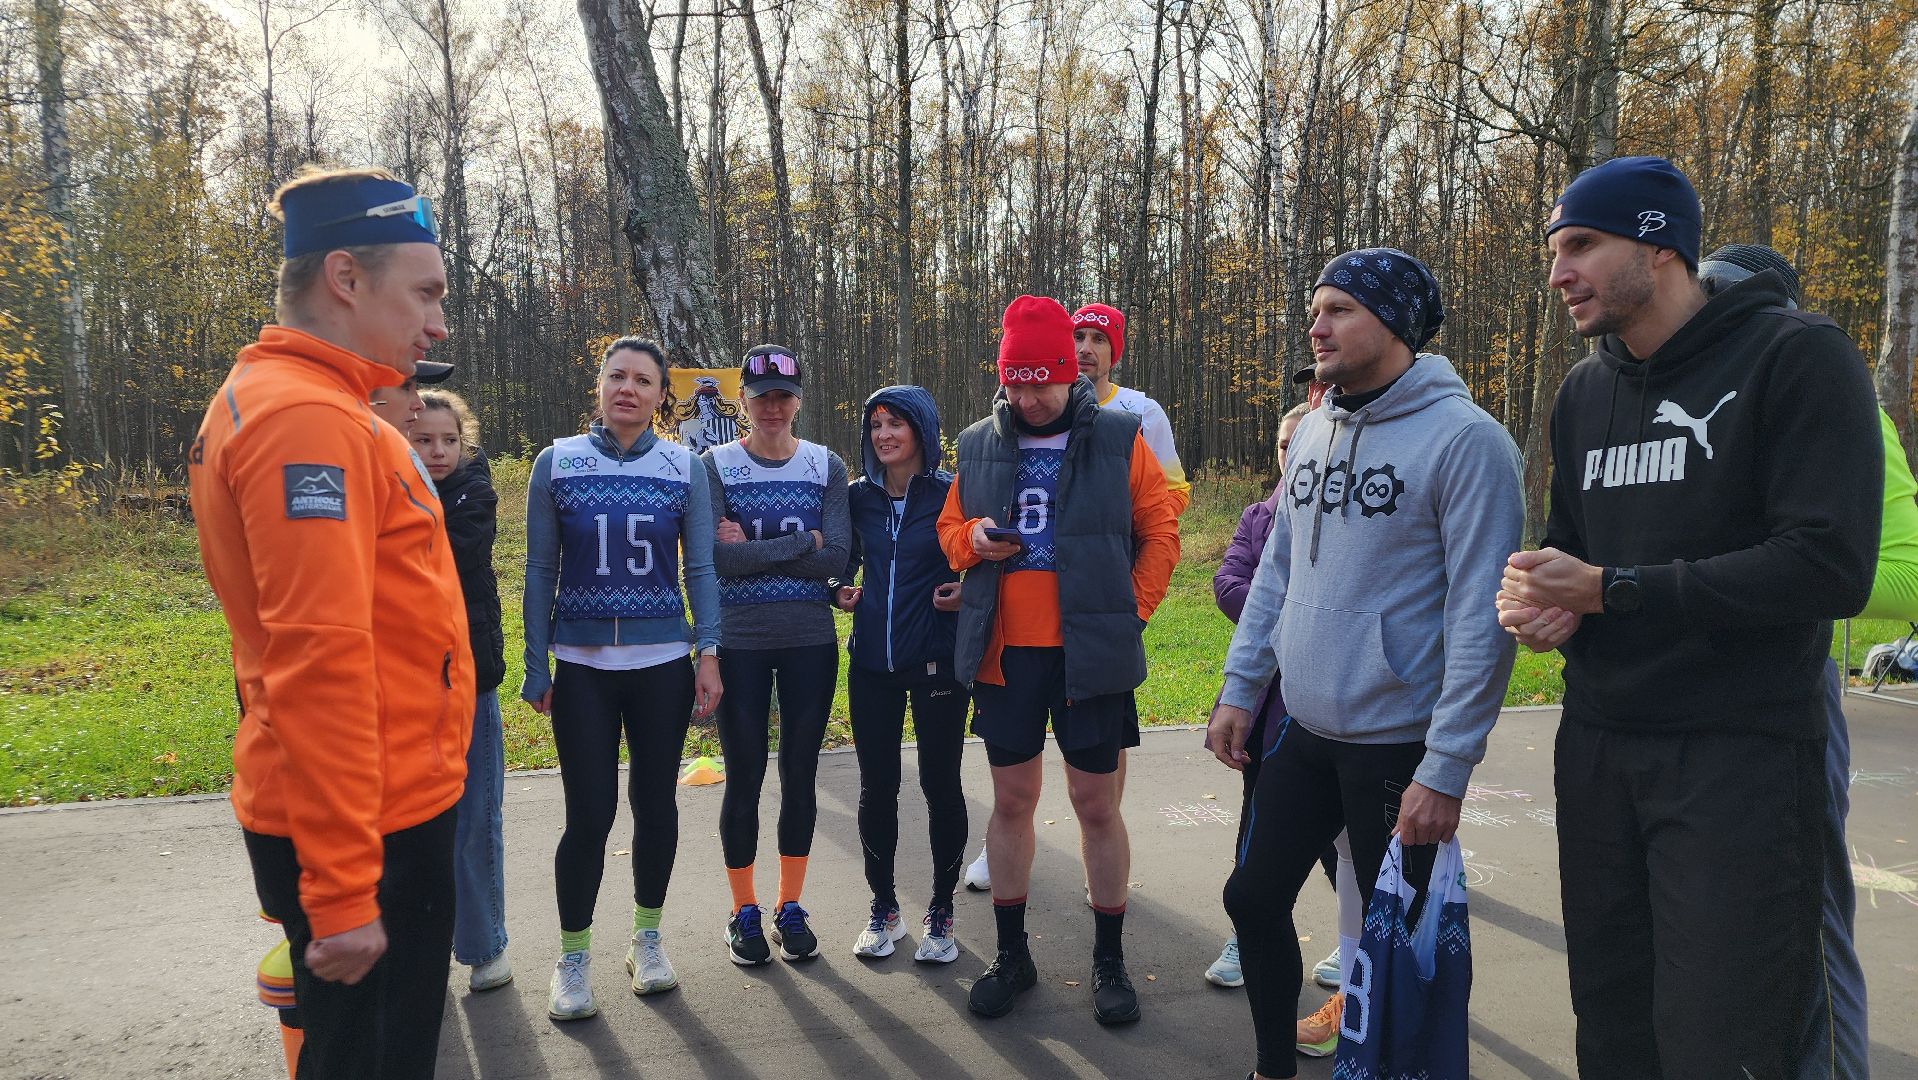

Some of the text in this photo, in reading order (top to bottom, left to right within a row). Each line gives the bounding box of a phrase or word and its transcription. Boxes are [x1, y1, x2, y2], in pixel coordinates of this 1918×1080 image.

[1582, 436, 1688, 491] PUMA
[1017, 487, 1049, 535] 8
[593, 513, 655, 576] 15
